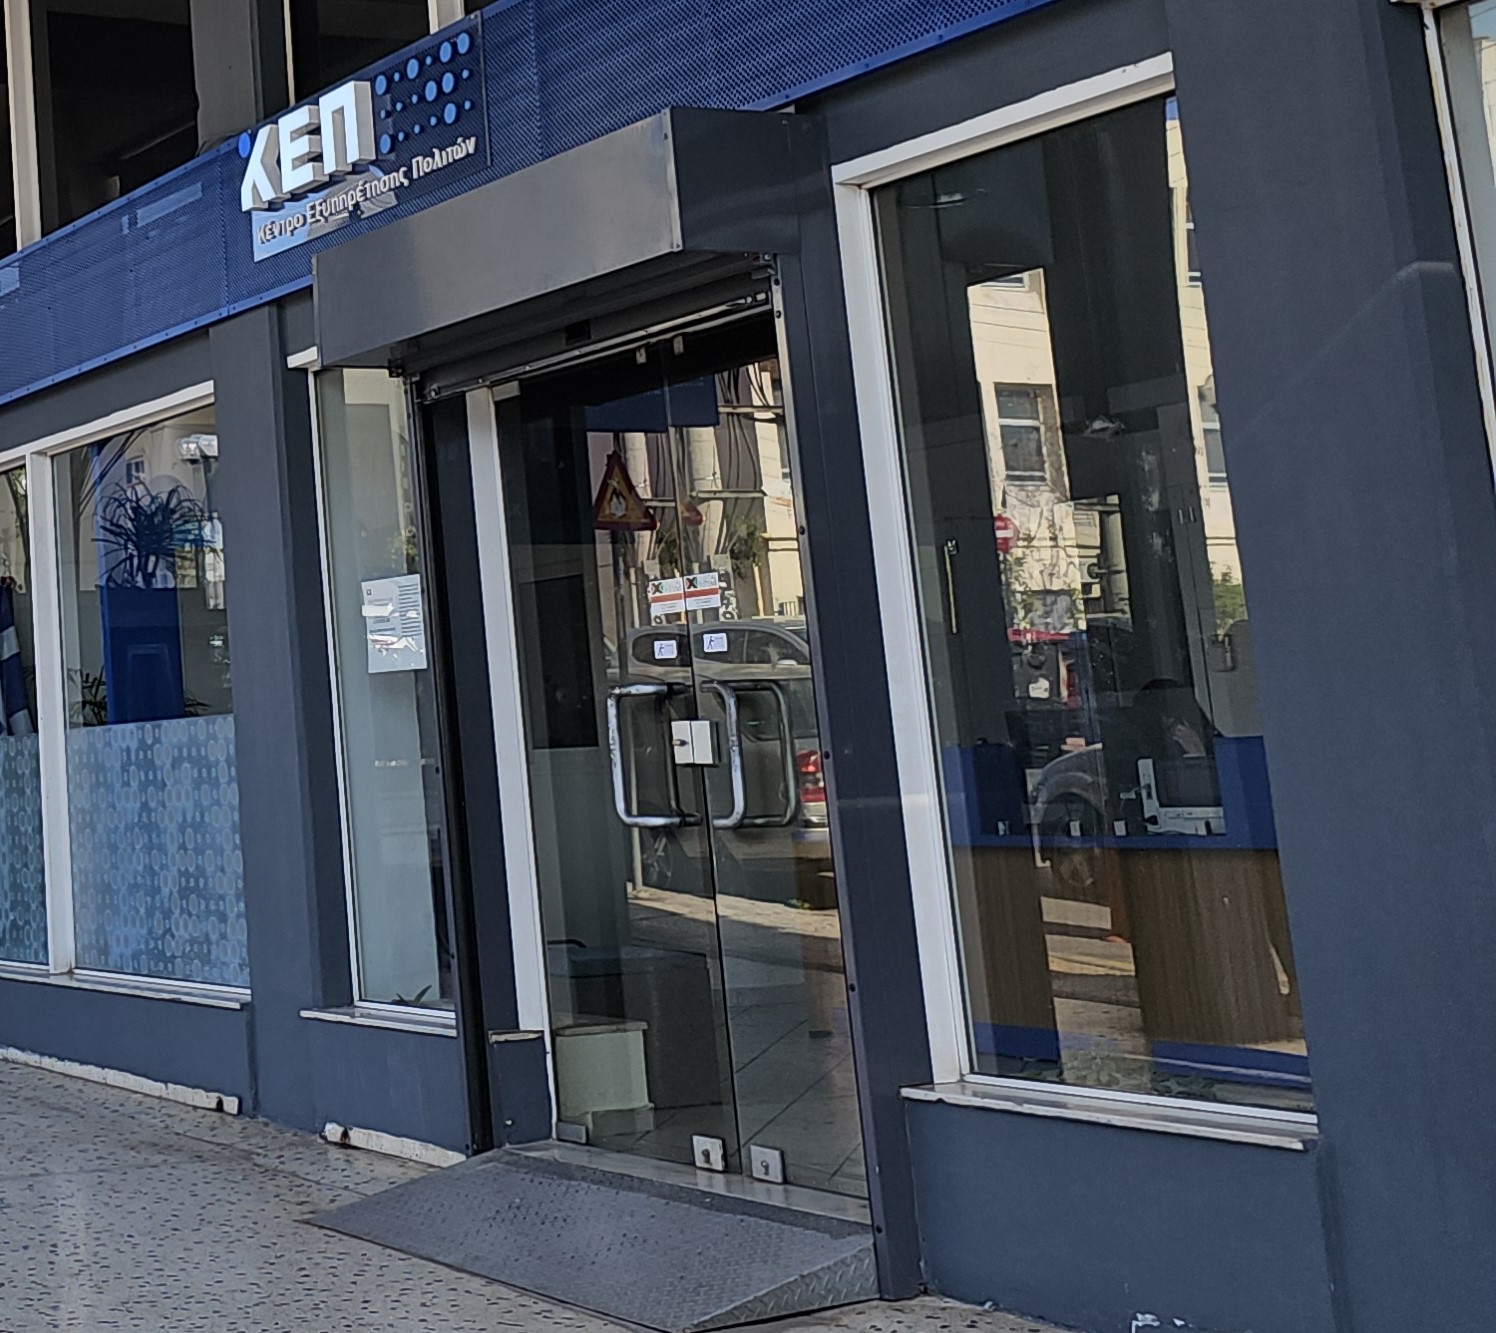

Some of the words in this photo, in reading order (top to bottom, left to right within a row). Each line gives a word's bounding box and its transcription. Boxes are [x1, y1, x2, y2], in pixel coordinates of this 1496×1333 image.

[241, 80, 375, 211] ΚΕΠ
[257, 213, 305, 244] Κέντρο
[306, 167, 409, 224] Εξυπηρέτησης
[411, 136, 477, 179] Πολιτών
